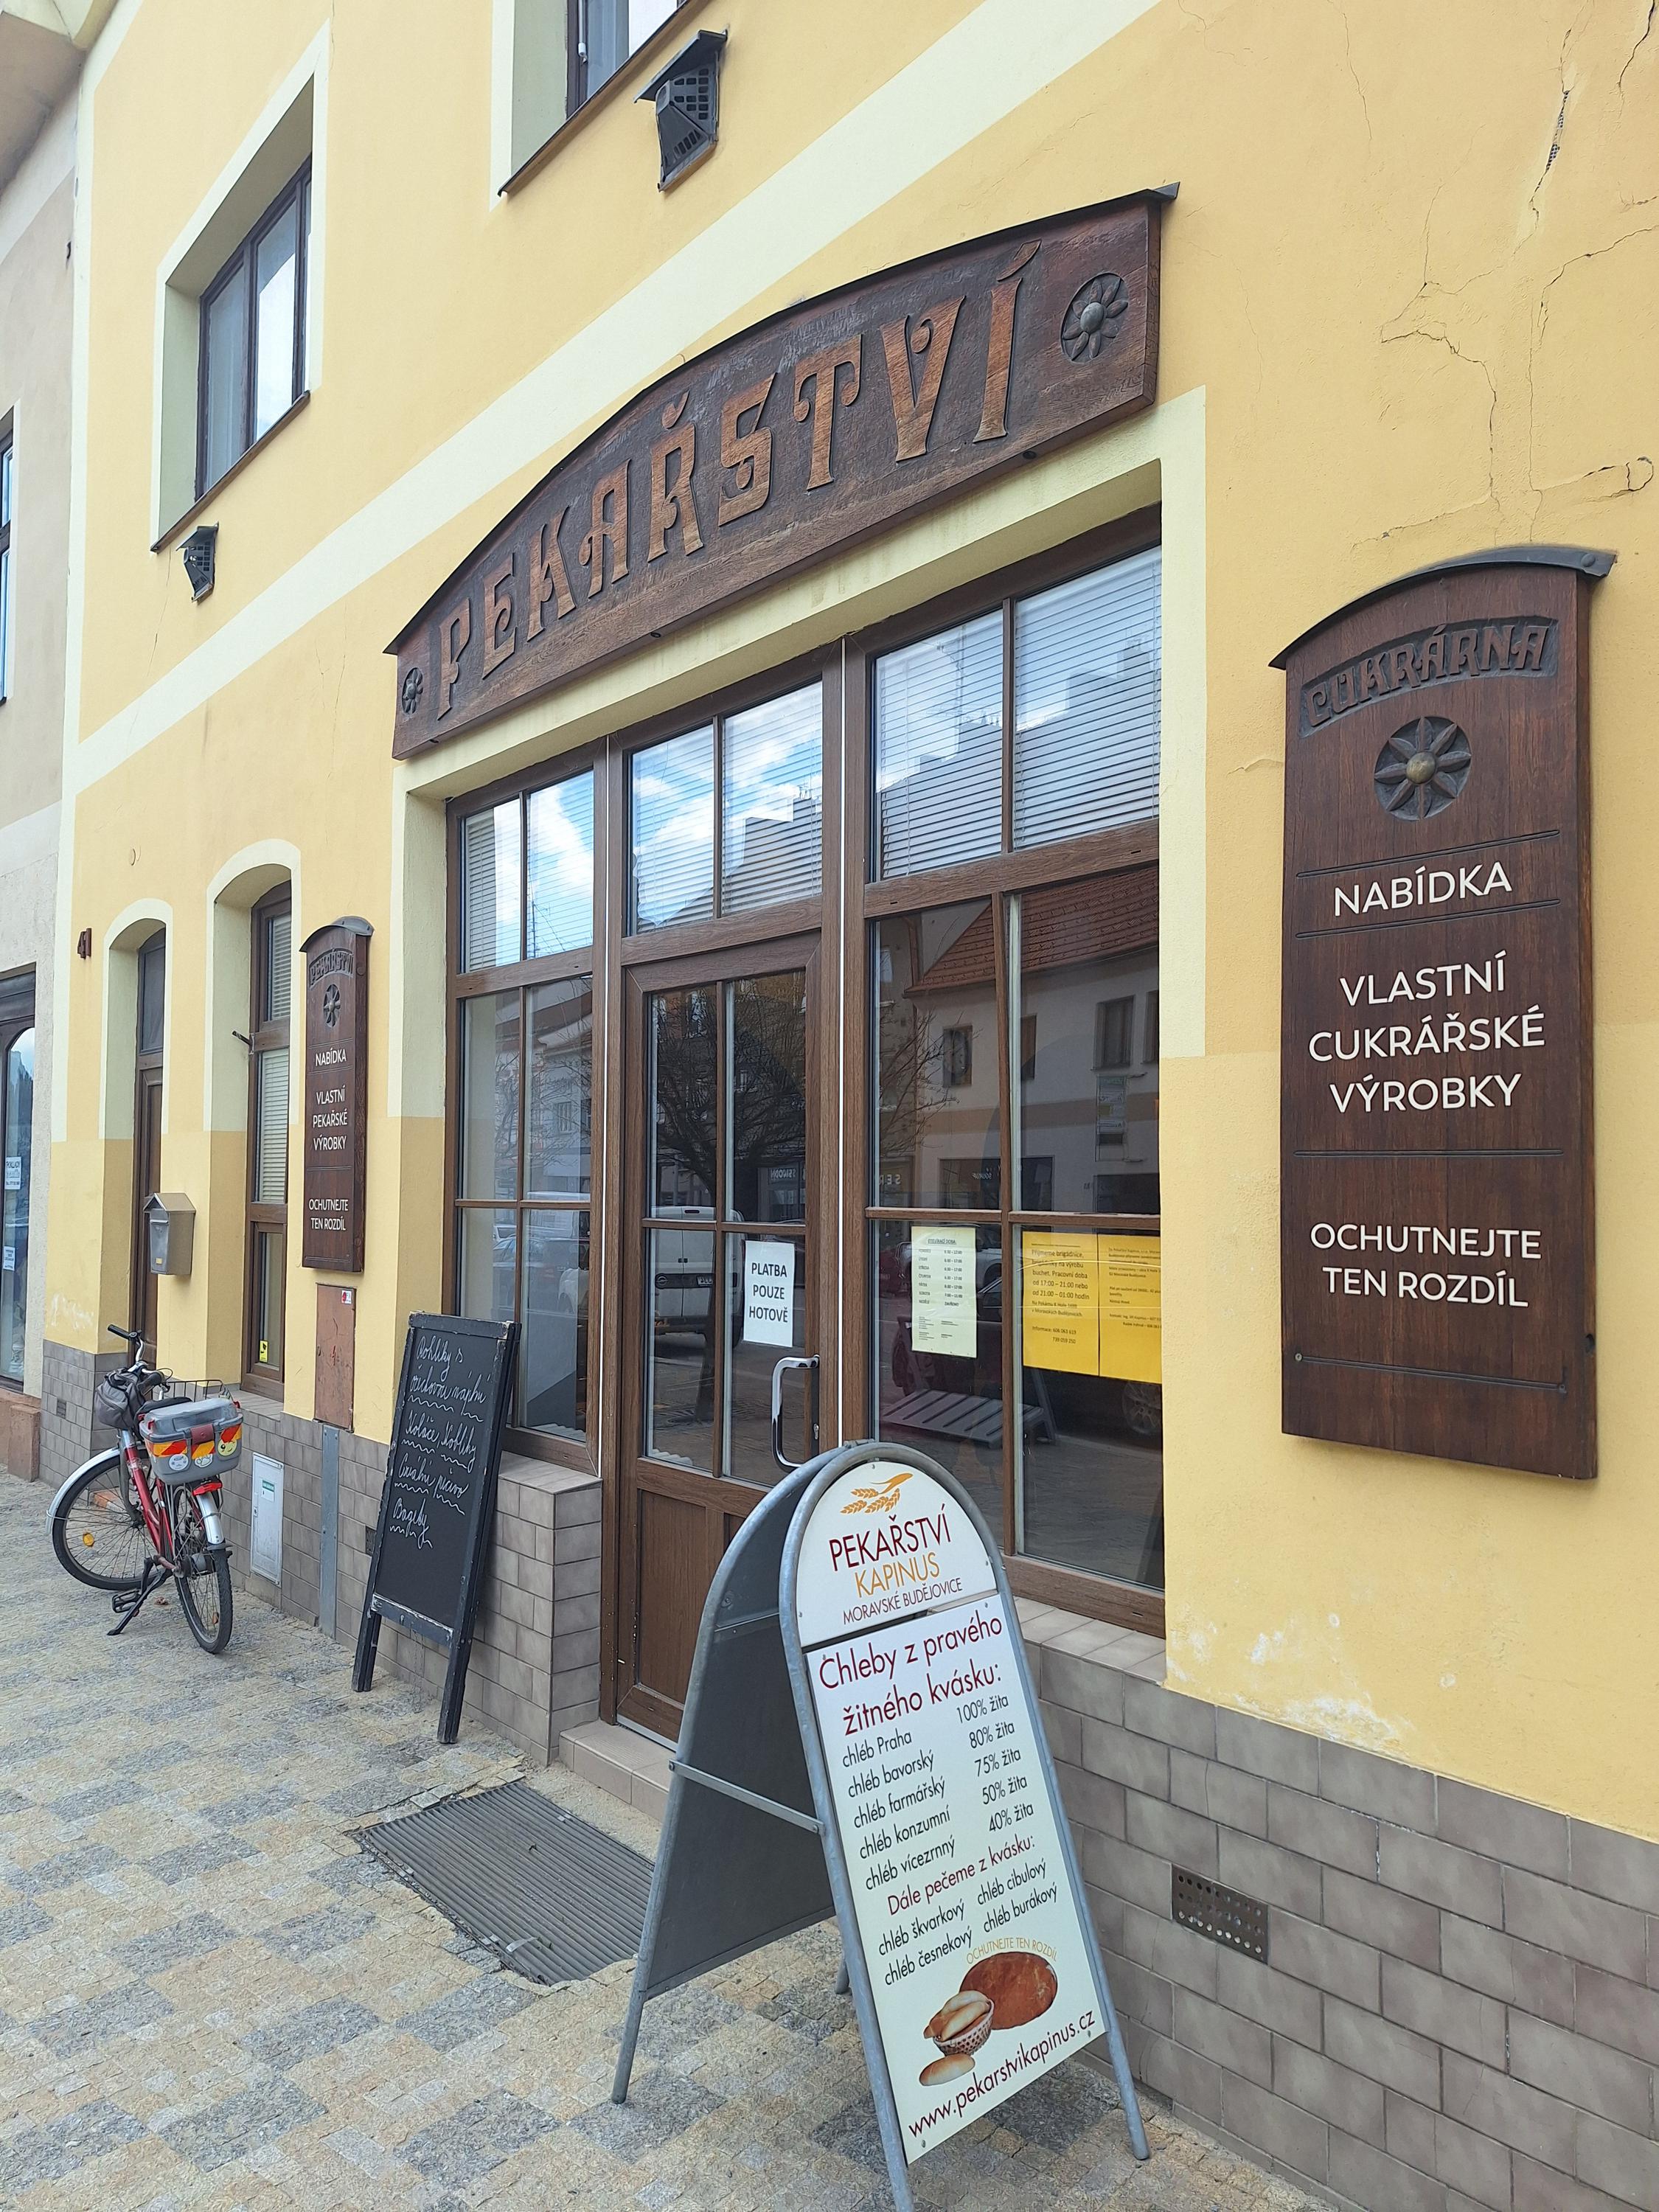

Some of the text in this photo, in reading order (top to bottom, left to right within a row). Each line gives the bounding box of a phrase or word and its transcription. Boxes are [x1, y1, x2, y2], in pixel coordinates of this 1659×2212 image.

[437, 240, 1043, 722] PEKAŘSTVÍ
[1307, 623, 1549, 727] CUKRÁRNA
[1332, 860, 1512, 917] NABÍDKA
[1339, 949, 1508, 1007] VLASTNÍ
[315, 1047, 347, 1067] NABÍDKA
[1308, 1004, 1546, 1062] CUKRÁŘSKÉ
[313, 1108, 348, 1128] PEKAŘSKÉ
[316, 1085, 346, 1105] VLASTNÍ
[1329, 1072, 1522, 1114] VÝROBKY
[313, 1134, 347, 1151] VÝROBKY
[308, 1199, 349, 1211] OCHUTNEJTE
[310, 1215, 346, 1231] TEN ROZDÍL
[1310, 1222, 1543, 1260] OCHUTNEJTE
[751, 1262, 787, 1278] PLATBA
[753, 1284, 785, 1300] POUZE
[1322, 1265, 1529, 1308] TEN ROZDÍL
[749, 1306, 788, 1323] HOTOVĚ
[829, 1503, 952, 1572] PEKAŘSTVÍ
[842, 1577, 964, 1625] MORAVSKÉ BUDĚJOVICE
[854, 1551, 941, 1599] KAPINUS
[819, 1609, 1003, 1689] Chleby z pravého
[843, 1658, 1003, 1736] žitného kvásku:
[842, 1694, 1009, 1769] chléb Praha 100% žita
[847, 1720, 1016, 1799] chléb bavorský 80% žita
[853, 1747, 1022, 1829] chléb farmářský 75% žita
[859, 1775, 1028, 1860] chléb konzumní 50% žita
[865, 1802, 1034, 1891] chléb vícezrnný 40% žita
[887, 1834, 1036, 1916] Dále pečeme z kvásku:
[976, 1858, 1047, 1907] chléb cibulový
[878, 1898, 966, 1957] chléb škvarkový
[983, 1882, 1058, 1934] chléb burákový
[884, 1927, 973, 1986] chléb česnekový
[966, 1937, 1015, 1964] OCHUTNEJTE
[1016, 1936, 1031, 1950] TEN
[908, 2009, 1096, 2138] www.pekarstvikapinus.cz
